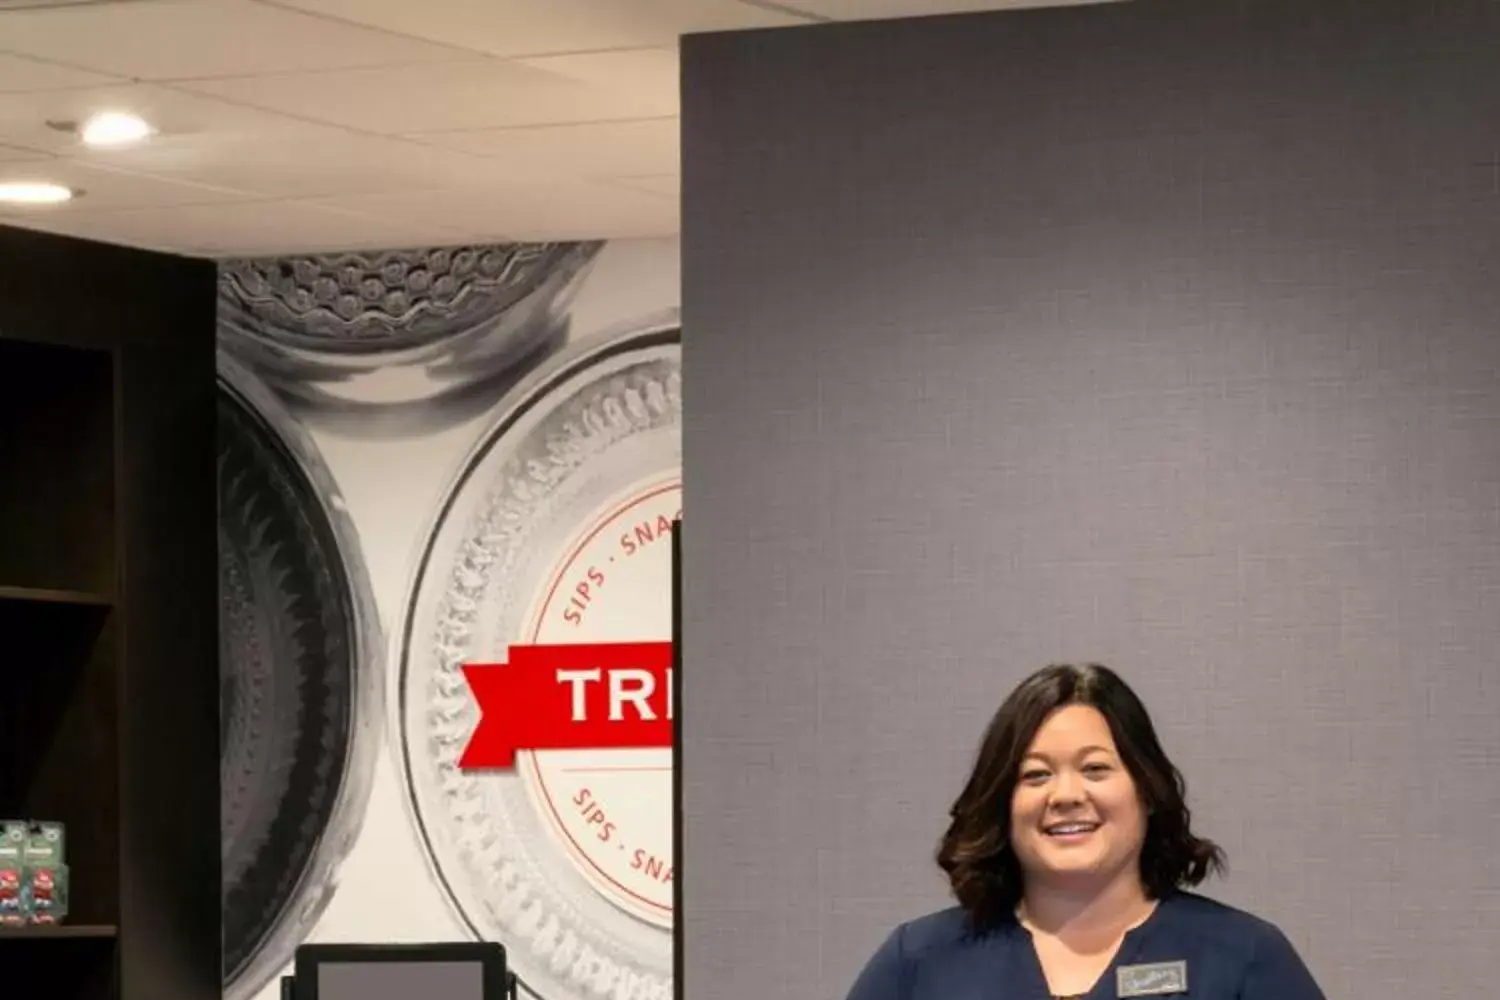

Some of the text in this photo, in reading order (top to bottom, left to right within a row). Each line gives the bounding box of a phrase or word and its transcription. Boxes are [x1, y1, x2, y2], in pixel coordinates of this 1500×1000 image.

[563, 509, 683, 627] SIPS SNA
[572, 788, 616, 842] SIPS
